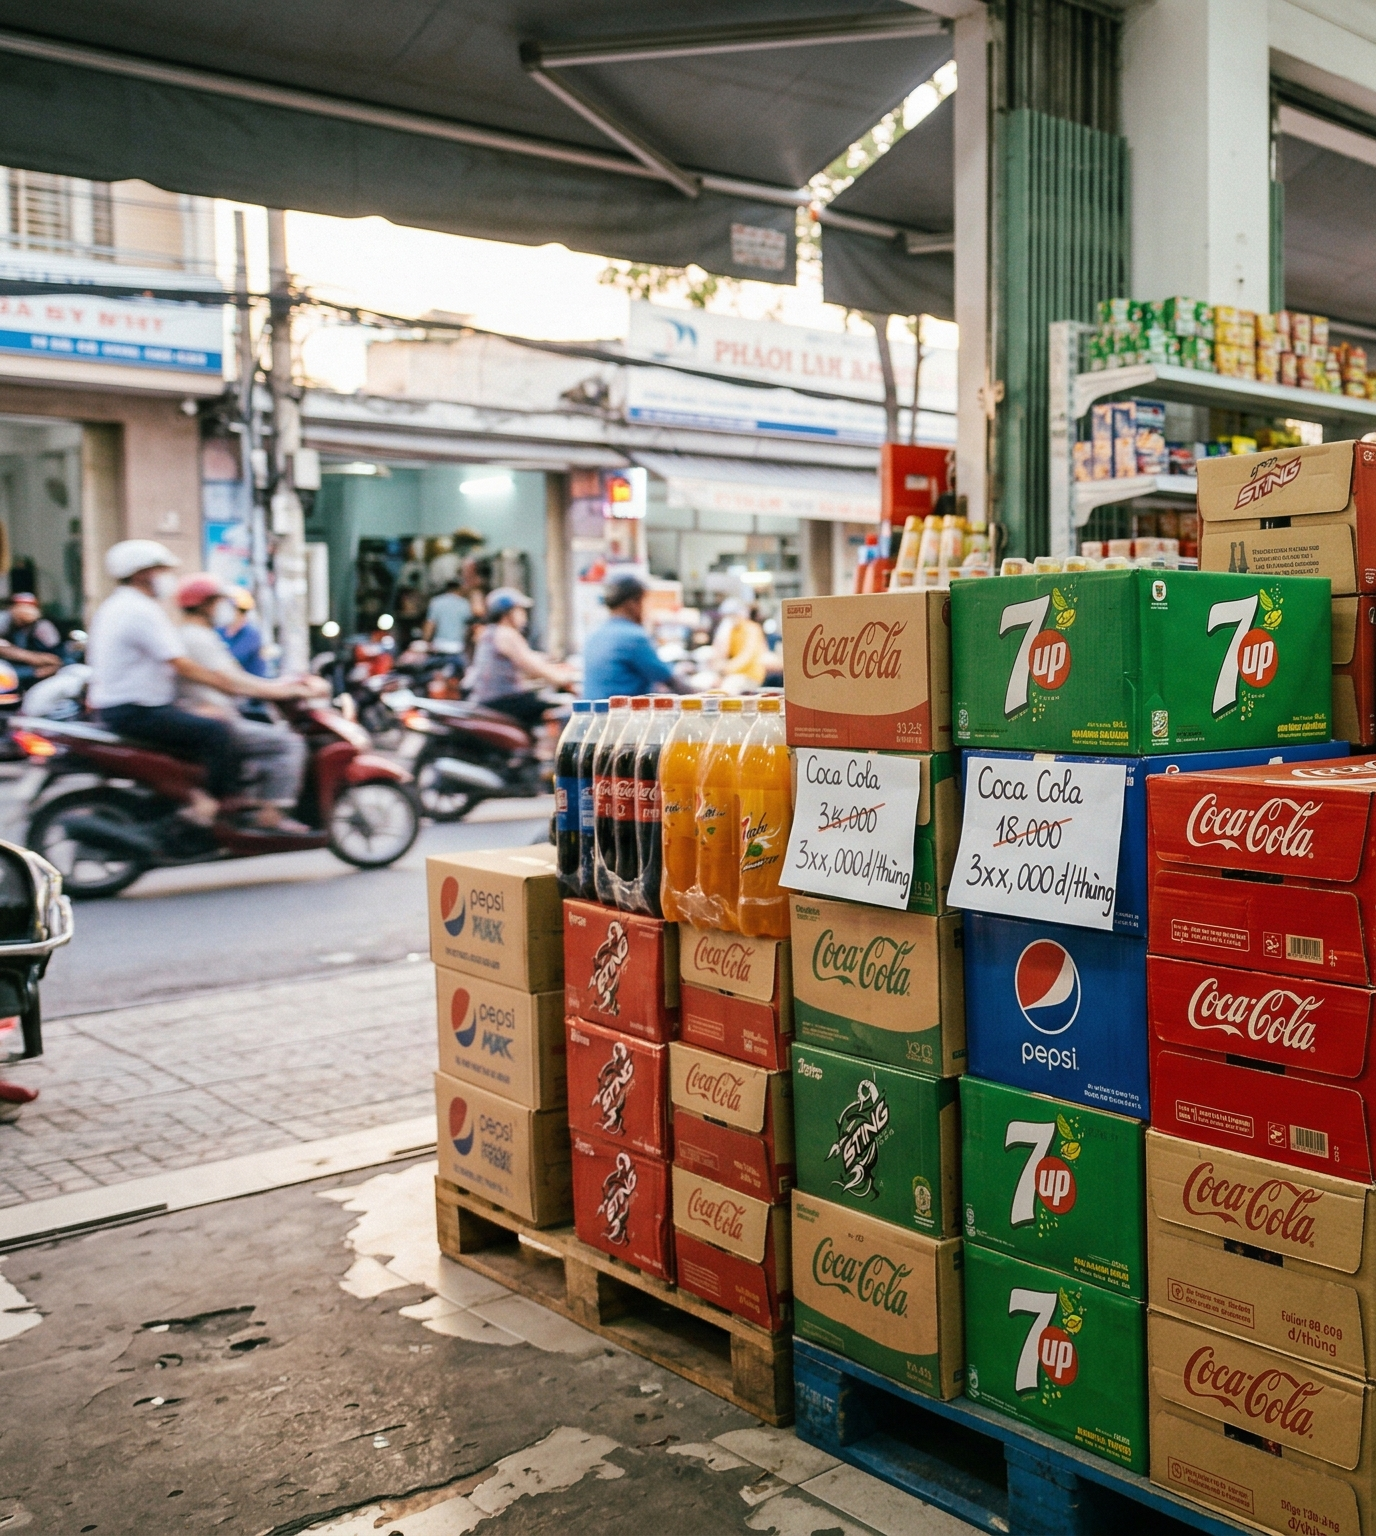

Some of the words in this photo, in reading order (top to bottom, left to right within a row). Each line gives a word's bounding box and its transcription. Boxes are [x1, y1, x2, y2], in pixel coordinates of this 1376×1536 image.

[806, 755, 843, 786] Coca
[846, 759, 881, 791] Cola
[978, 765, 1028, 801] Coca
[1036, 769, 1083, 805] Cola
[995, 814, 1062, 850] 18,000
[469, 888, 505, 914] pepsi
[479, 1002, 516, 1032] pepsi
[1021, 1042, 1077, 1071] pepsi
[842, 1099, 890, 1172] STING
